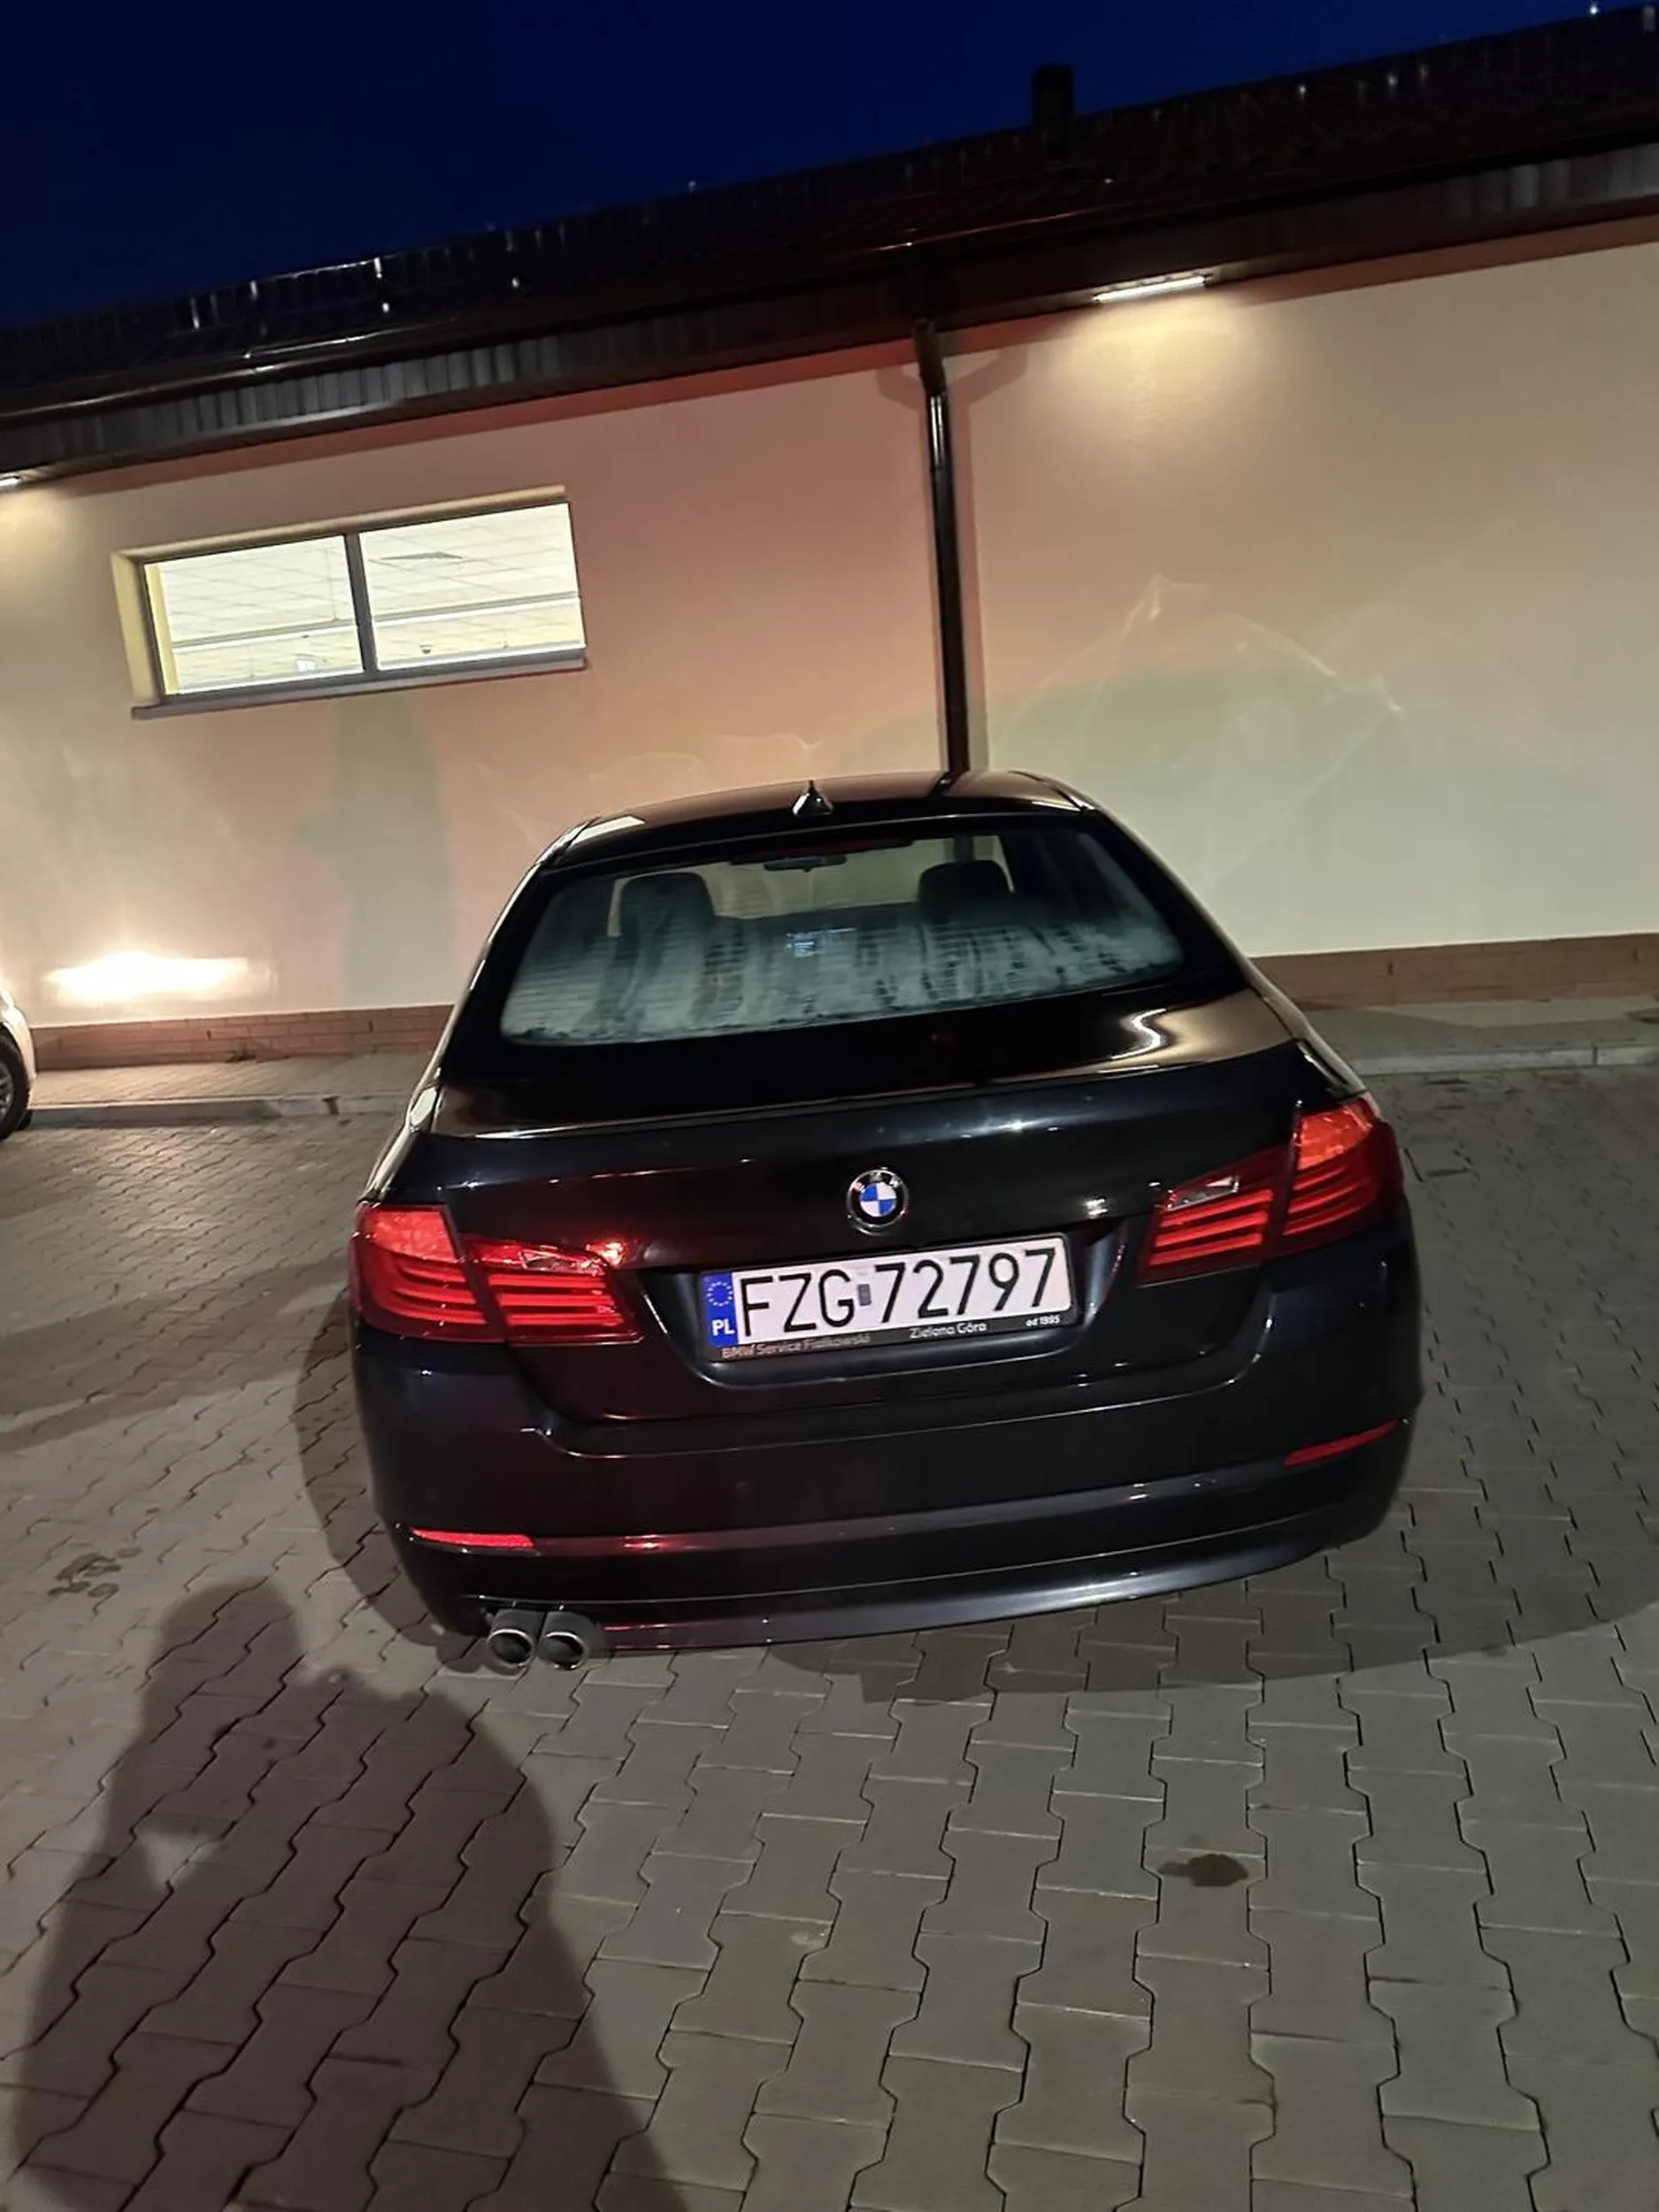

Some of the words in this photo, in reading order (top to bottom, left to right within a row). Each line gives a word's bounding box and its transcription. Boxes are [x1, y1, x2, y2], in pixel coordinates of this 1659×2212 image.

[740, 1269, 855, 1337] FZG
[874, 1247, 1056, 1324] 72797
[711, 1318, 735, 1336] PL
